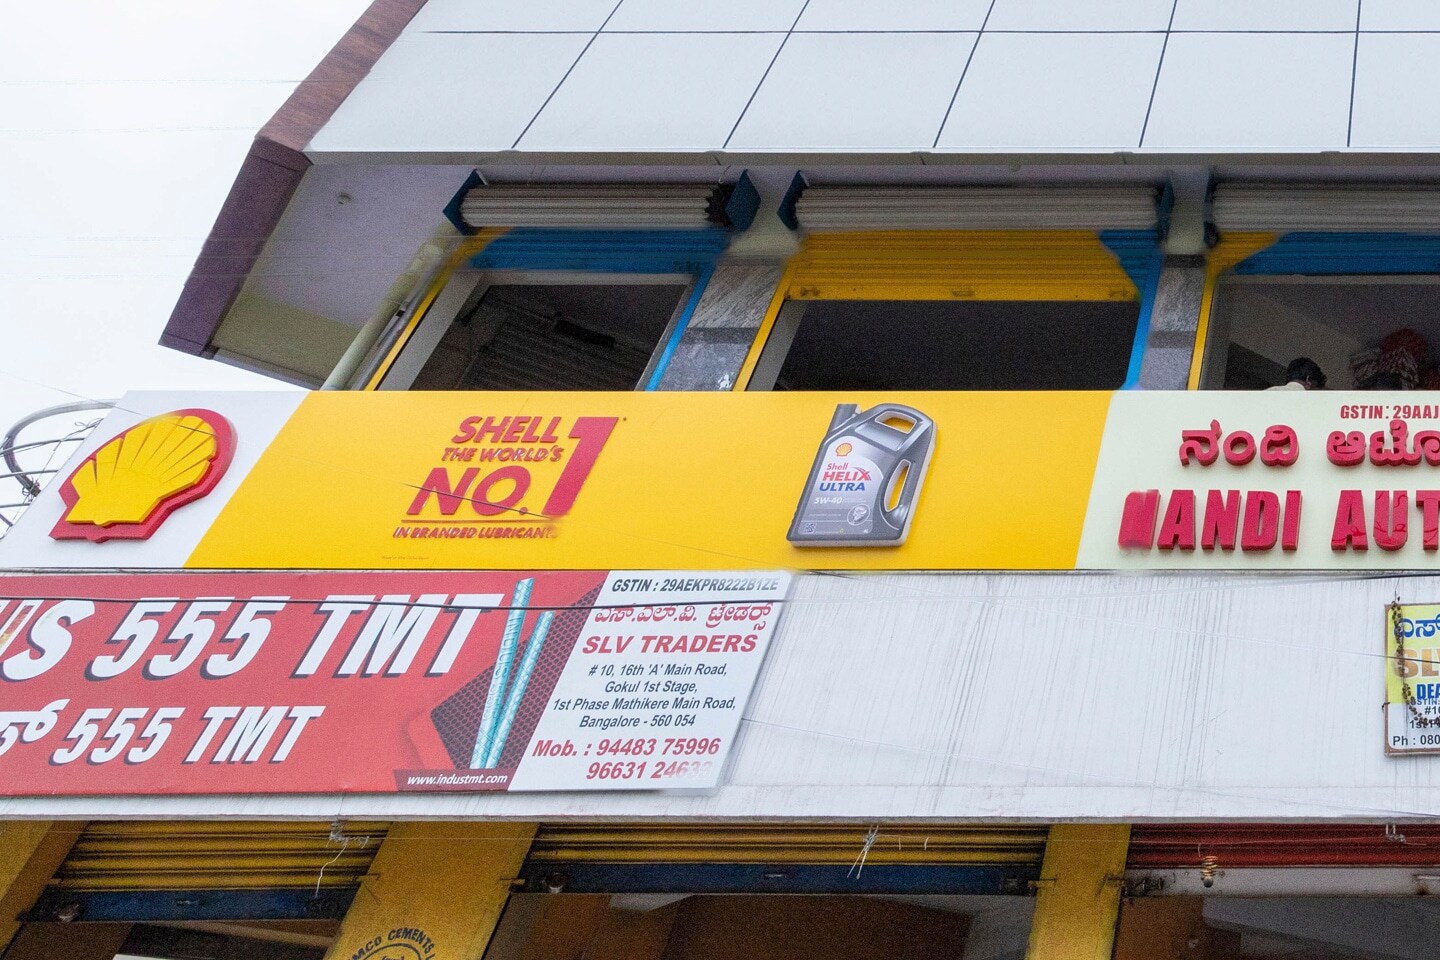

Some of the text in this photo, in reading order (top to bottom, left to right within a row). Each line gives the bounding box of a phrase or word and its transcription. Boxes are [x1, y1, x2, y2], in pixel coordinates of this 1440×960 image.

[451, 415, 562, 444] SHELL
[1179, 419, 1300, 467] ನಂದಿ
[441, 444, 563, 462] THE WORLD'S
[540, 416, 620, 519] 1
[822, 467, 872, 481] HELIX
[826, 462, 849, 471] Shell
[819, 482, 866, 492] ULTRA
[393, 526, 558, 539] IN BRANDED LUBRICAN
[612, 579, 651, 592] GSTIN
[83, 596, 290, 681] 555
[291, 594, 506, 679] TMT
[582, 634, 758, 655] SLV TRADERS
[601, 664, 615, 678] 10,
[620, 664, 644, 676] 16th
[649, 663, 663, 676] 'A'
[664, 663, 692, 676] Main
[694, 663, 728, 677] Road,
[605, 680, 699, 695] Gokul 1st Stage,
[553, 697, 737, 711] 1st Phase Mathikere Main Road,
[1410, 696, 1440, 706] STIN:
[579, 715, 641, 731] Bangalore
[650, 714, 673, 727] 560
[674, 714, 697, 727] 054
[49, 707, 186, 766] 555
[183, 706, 326, 765] TMT
[1392, 736, 1409, 746] Ph
[532, 739, 578, 757] Mob.
[596, 738, 656, 756] 94483
[661, 738, 721, 756] 75996
[586, 761, 647, 780] 96631
[407, 773, 508, 785] www.industmt.com
[387, 927, 436, 954] CEMENTS
